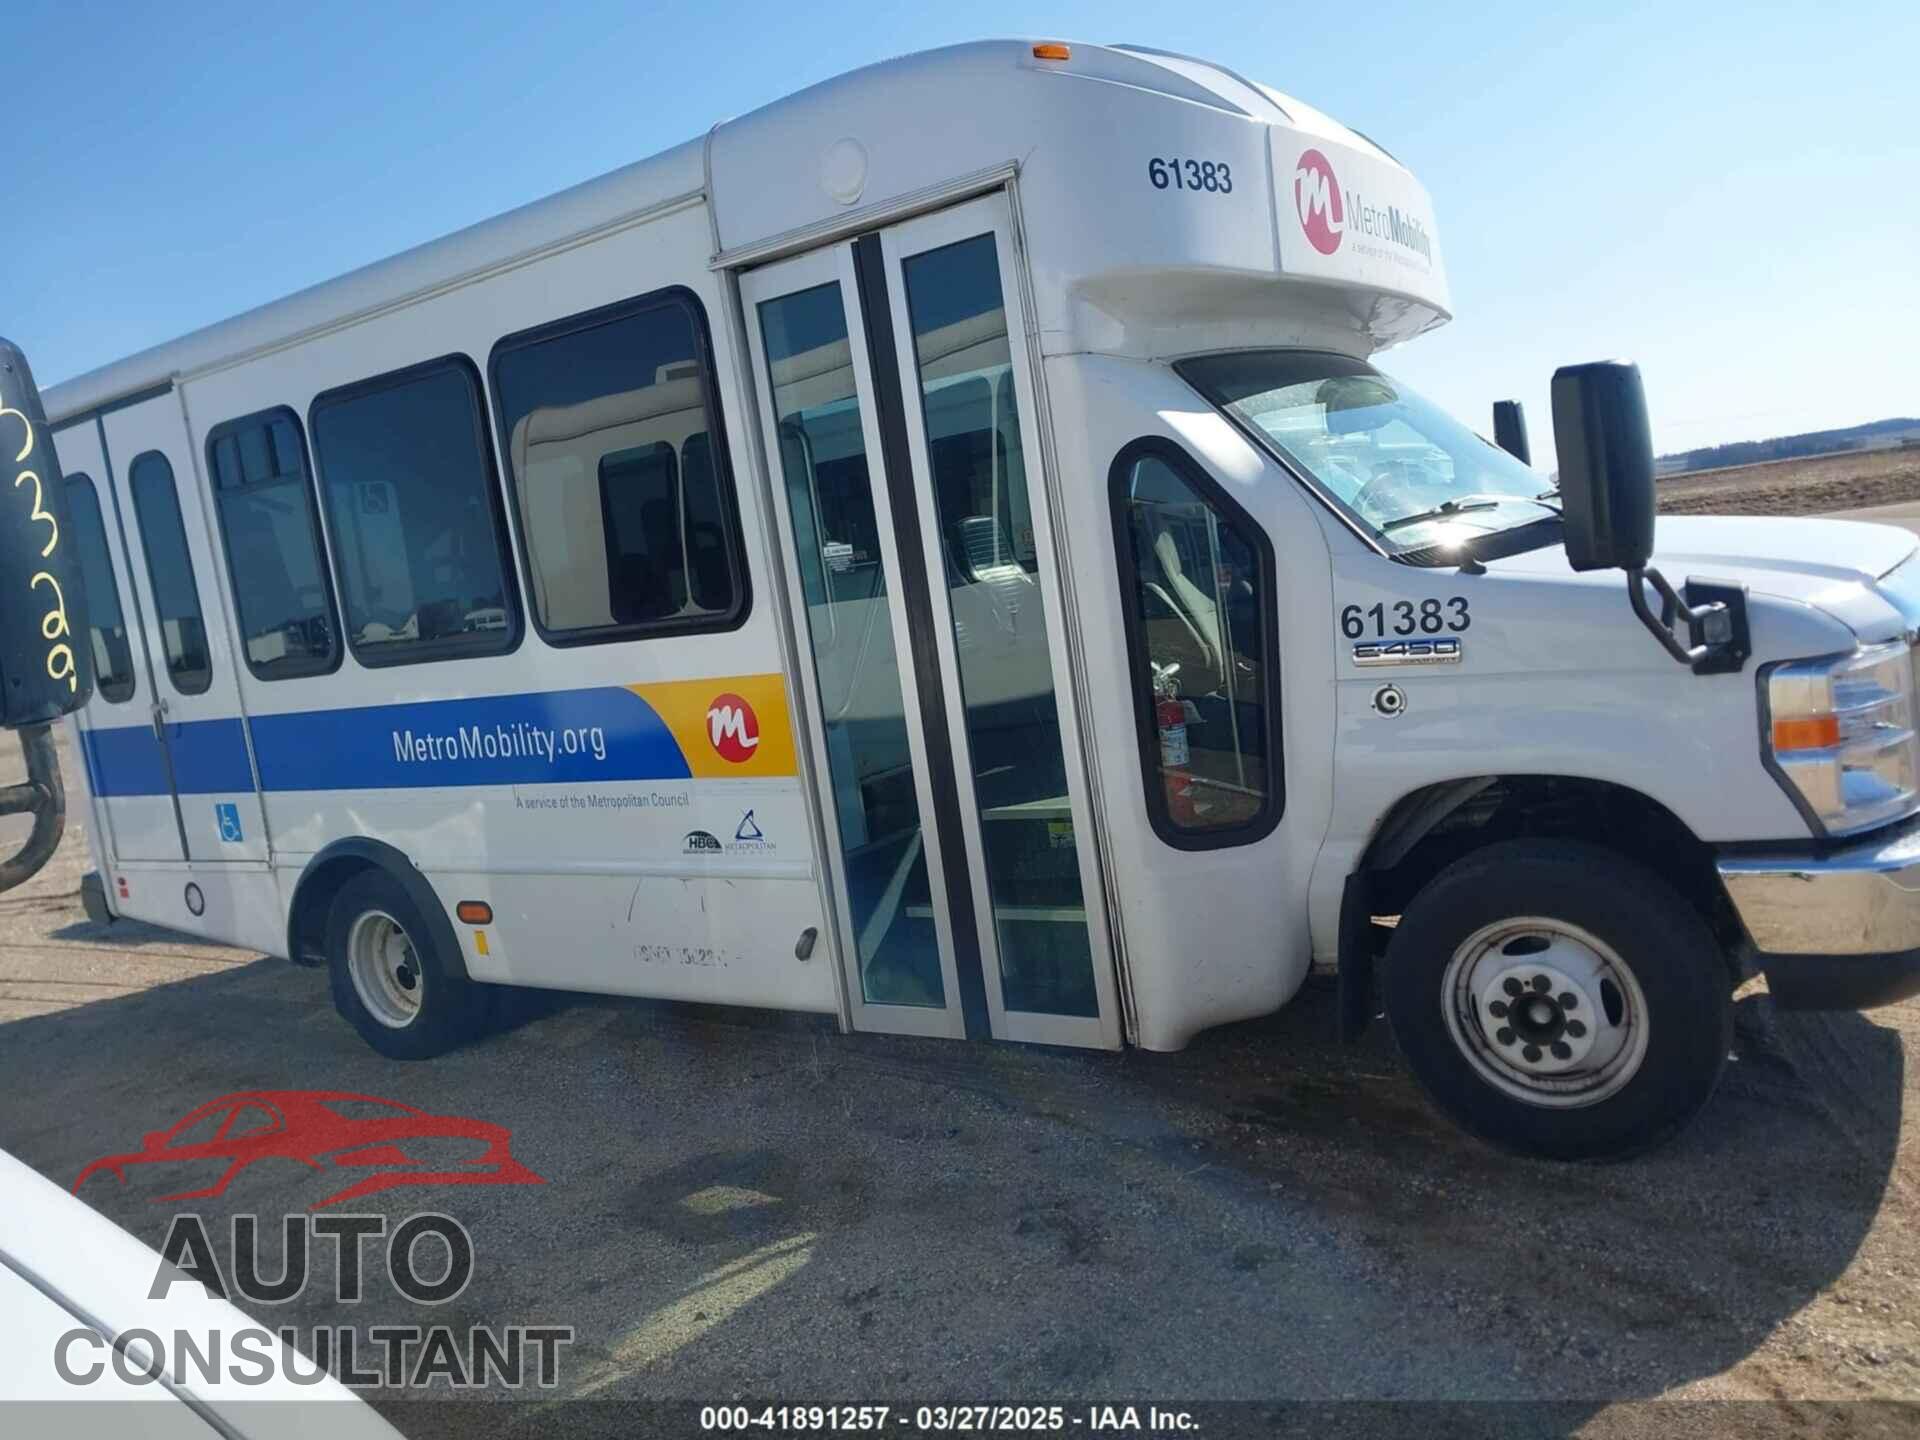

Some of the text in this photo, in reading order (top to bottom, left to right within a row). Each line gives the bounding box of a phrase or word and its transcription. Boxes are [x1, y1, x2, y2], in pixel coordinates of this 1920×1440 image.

[1149, 157, 1232, 194] 61383
[1341, 597, 1471, 639] 61383
[393, 726, 607, 763] MetroMobility.org
[516, 792, 690, 811] A service of the Metropolitan Council
